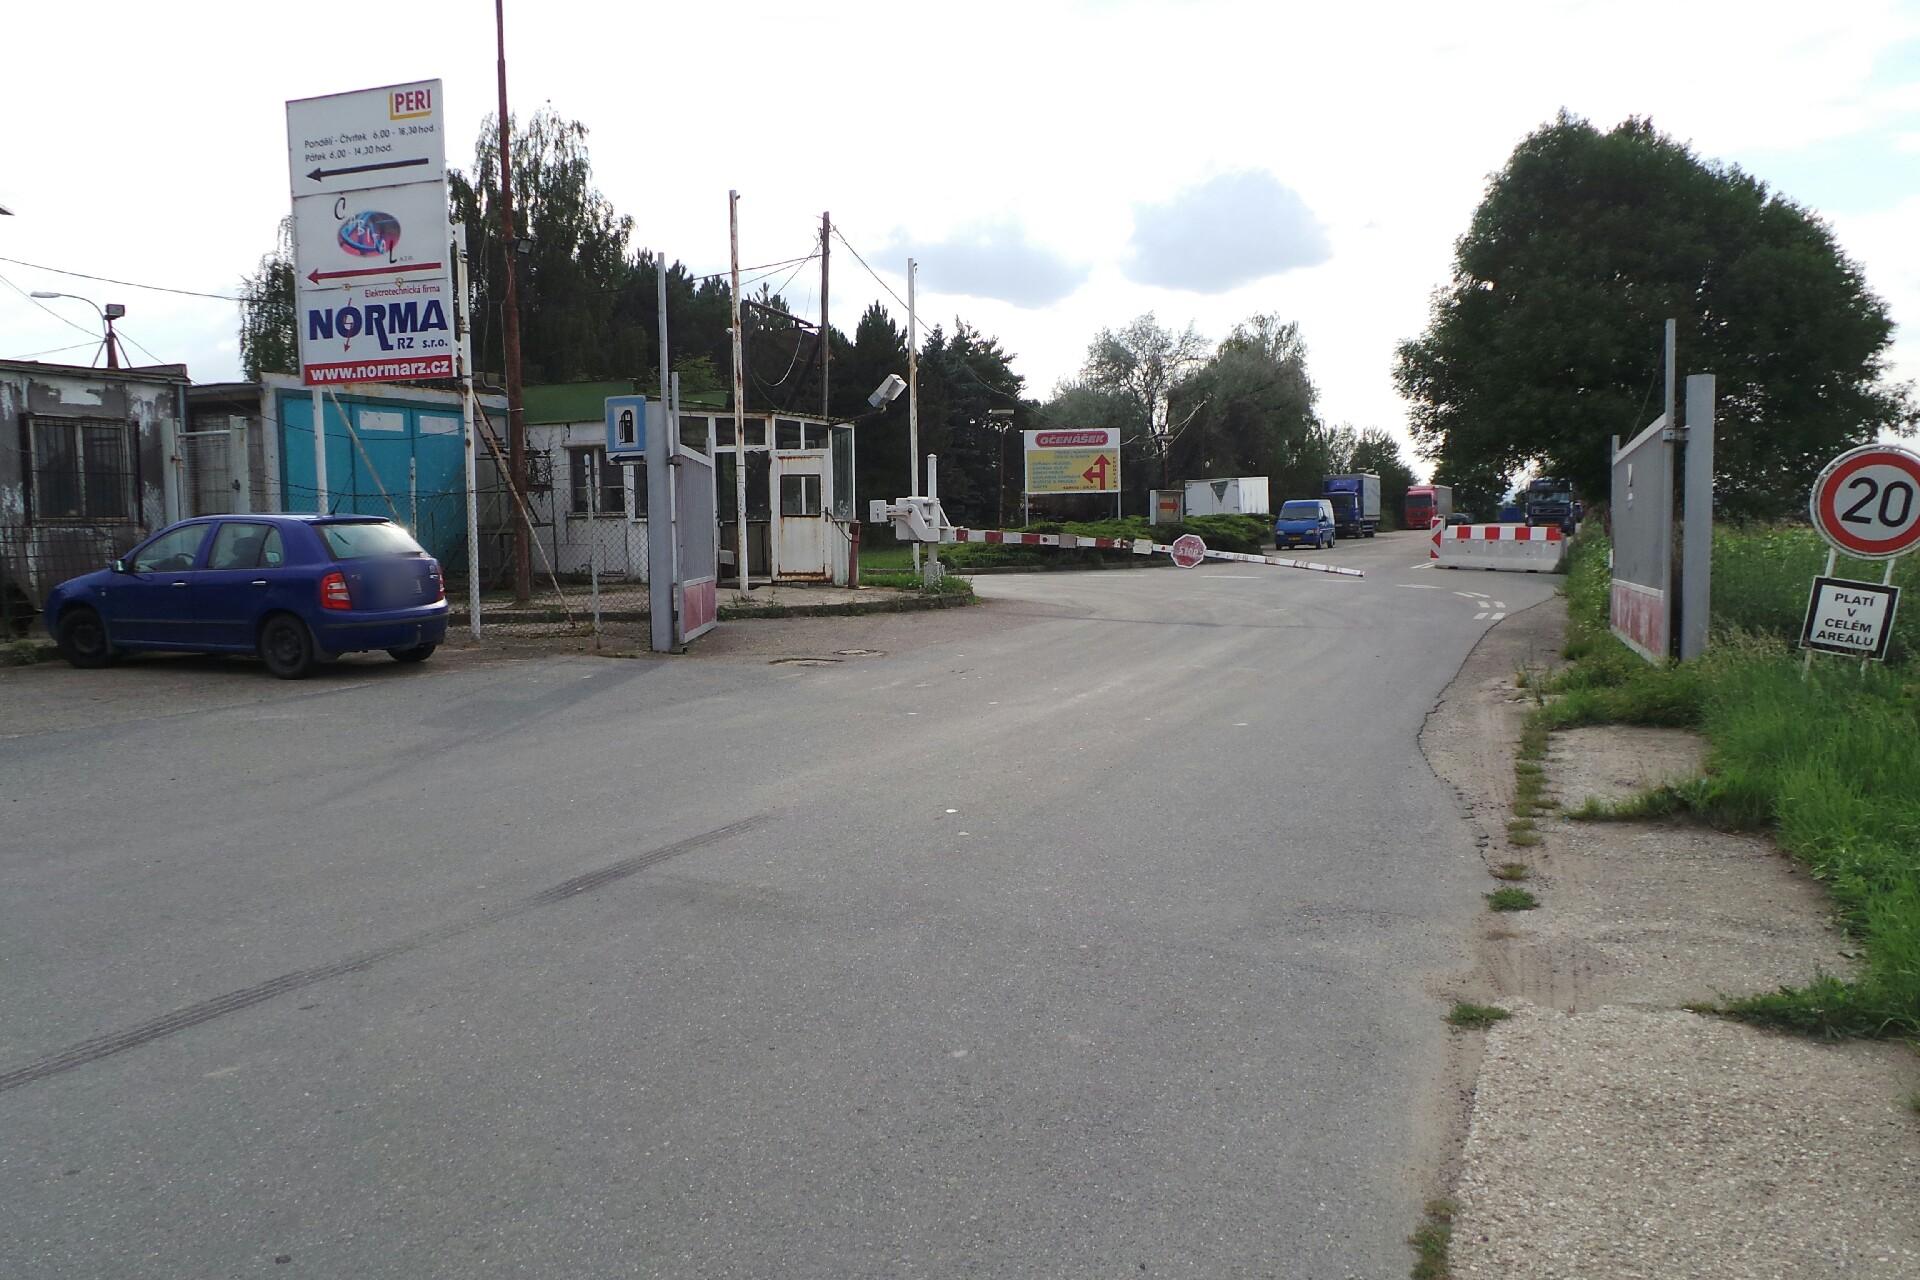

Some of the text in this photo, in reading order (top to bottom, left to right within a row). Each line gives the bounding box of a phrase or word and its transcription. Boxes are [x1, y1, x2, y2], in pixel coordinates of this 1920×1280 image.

[394, 88, 431, 113] PERI
[305, 151, 327, 163] Pátek
[364, 284, 441, 298] Elektrotechnická firma
[309, 299, 449, 351] NORMA
[397, 337, 448, 350] RZ s.r.o.
[311, 360, 450, 381] www.normarz.cz
[1841, 477, 1914, 528] 20
[1834, 592, 1876, 607] PLATÍ
[1846, 607, 1857, 618] V
[1824, 618, 1872, 633] CELÉM
[1815, 630, 1874, 647] AREÁLU
